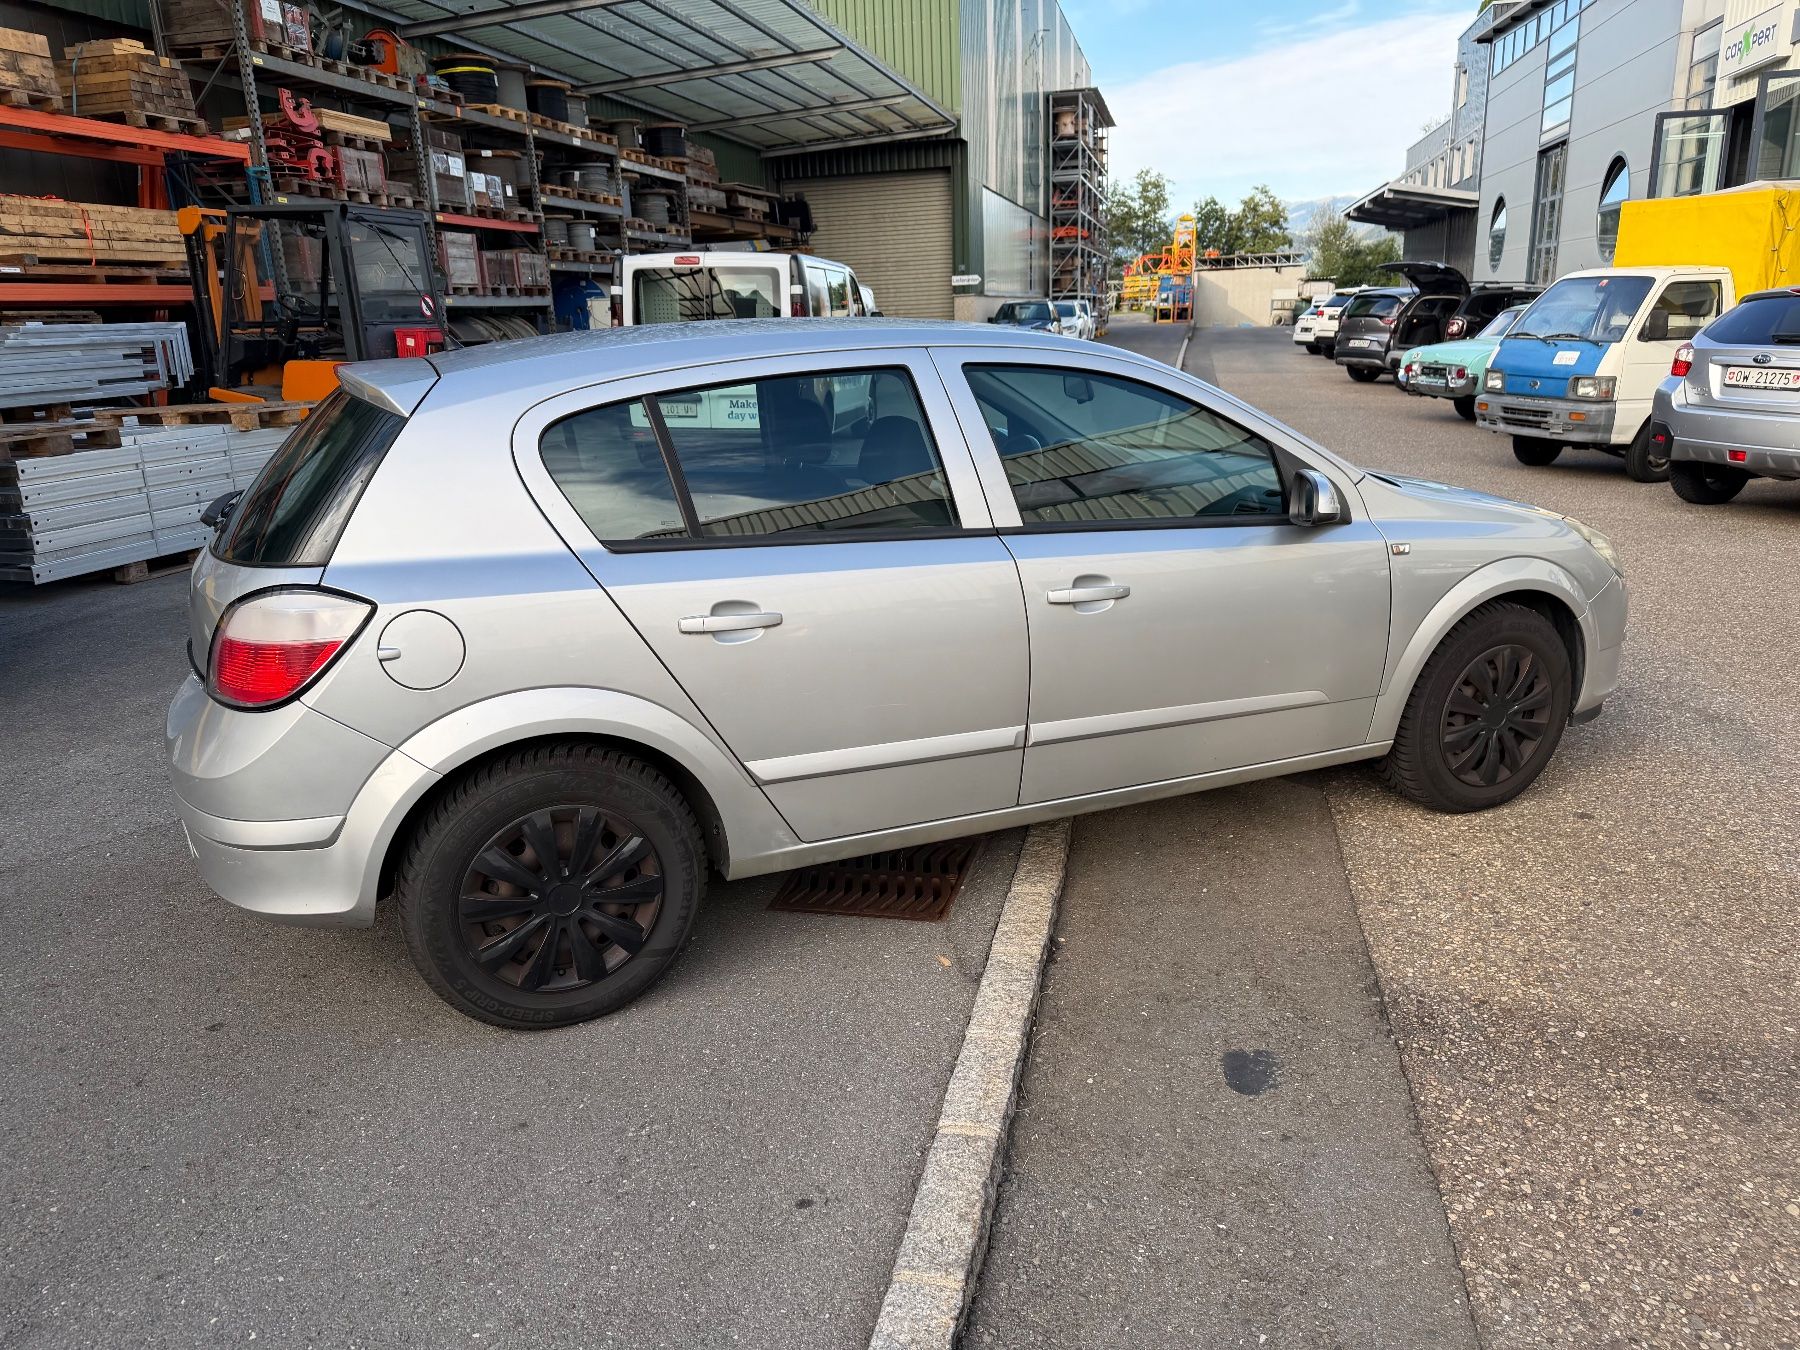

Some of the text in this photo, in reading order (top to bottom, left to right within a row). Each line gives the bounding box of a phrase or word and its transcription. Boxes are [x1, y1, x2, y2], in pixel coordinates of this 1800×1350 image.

[729, 399, 757, 409] Make
[727, 410, 746, 422] day
[463, 987, 556, 1022] SPEED-GRIP
